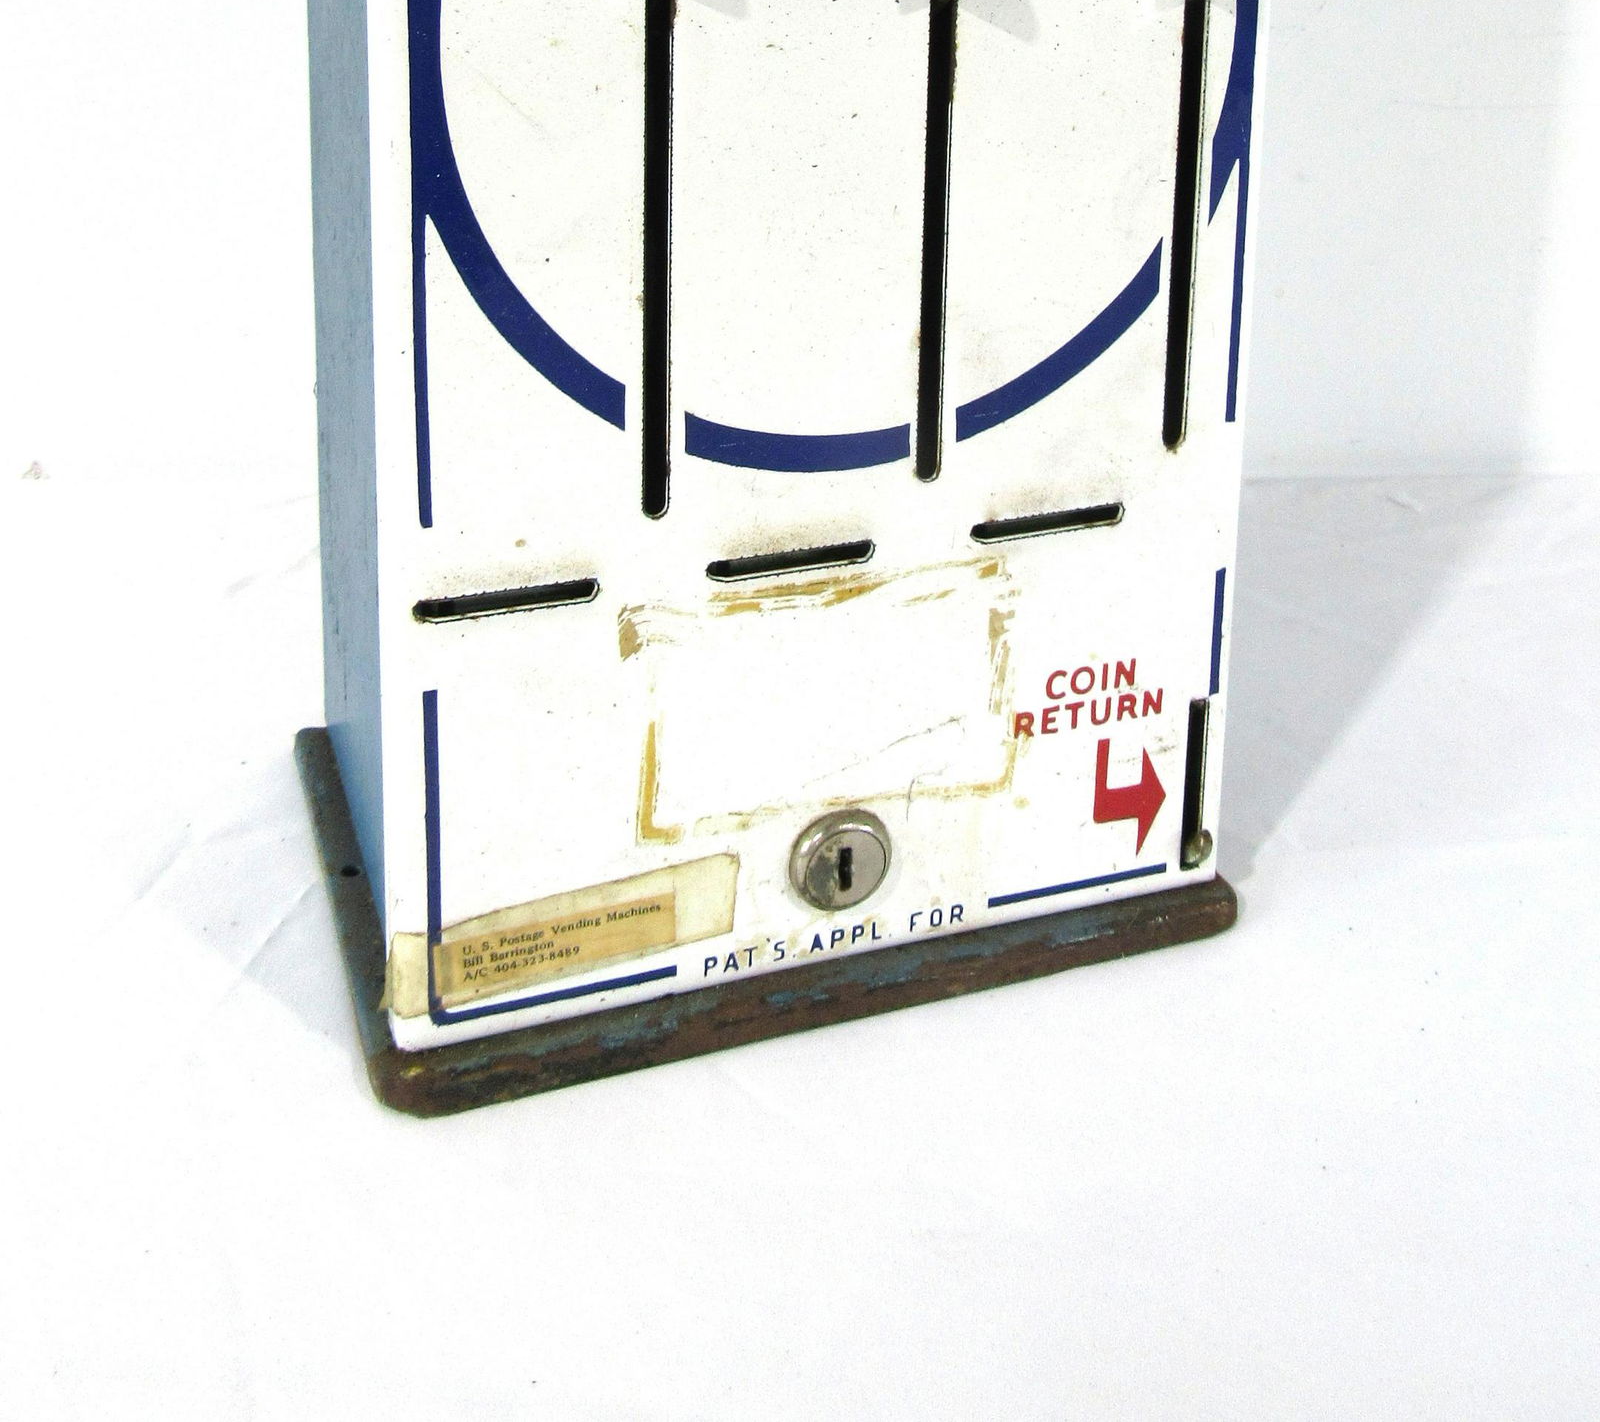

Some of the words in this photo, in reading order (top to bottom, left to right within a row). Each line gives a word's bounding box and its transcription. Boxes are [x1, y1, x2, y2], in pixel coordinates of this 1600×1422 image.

[1046, 658, 1136, 700] COIN
[1014, 688, 1163, 739] RETURN
[500, 929, 545, 947] Postage
[551, 916, 601, 936] Vending
[606, 904, 661, 922] Machines
[909, 904, 965, 932] FOR
[463, 956, 484, 969] Bill
[463, 967, 488, 982] A/C
